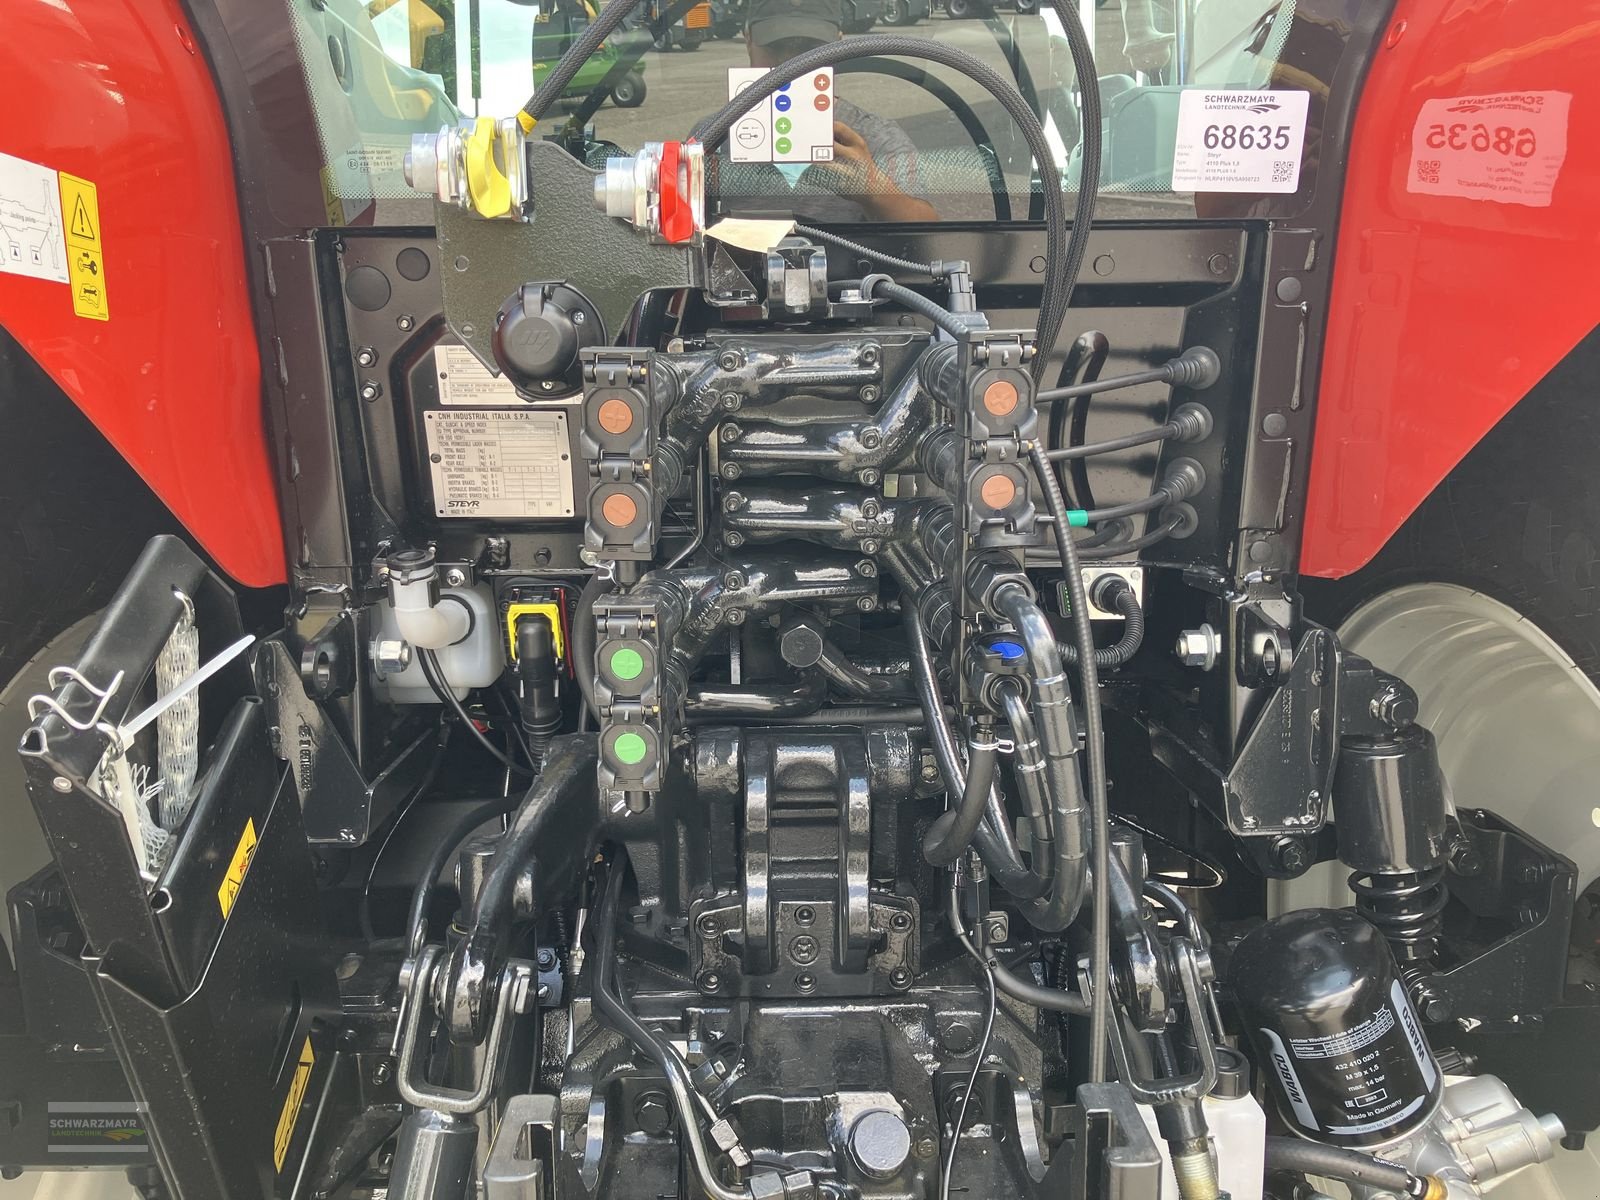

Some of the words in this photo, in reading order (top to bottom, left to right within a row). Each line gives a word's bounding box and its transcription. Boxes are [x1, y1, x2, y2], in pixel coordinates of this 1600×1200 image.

[1204, 95, 1275, 103] SCHWARZMAYR
[1203, 124, 1291, 150] 68635
[1402, 1006, 1424, 1062] WABCO
[1349, 1059, 1362, 1067] 410
[1362, 1053, 1375, 1062] 020
[1275, 1054, 1303, 1104] WABCO
[1375, 1075, 1385, 1083] bar
[1374, 1098, 1402, 1114] Germany
